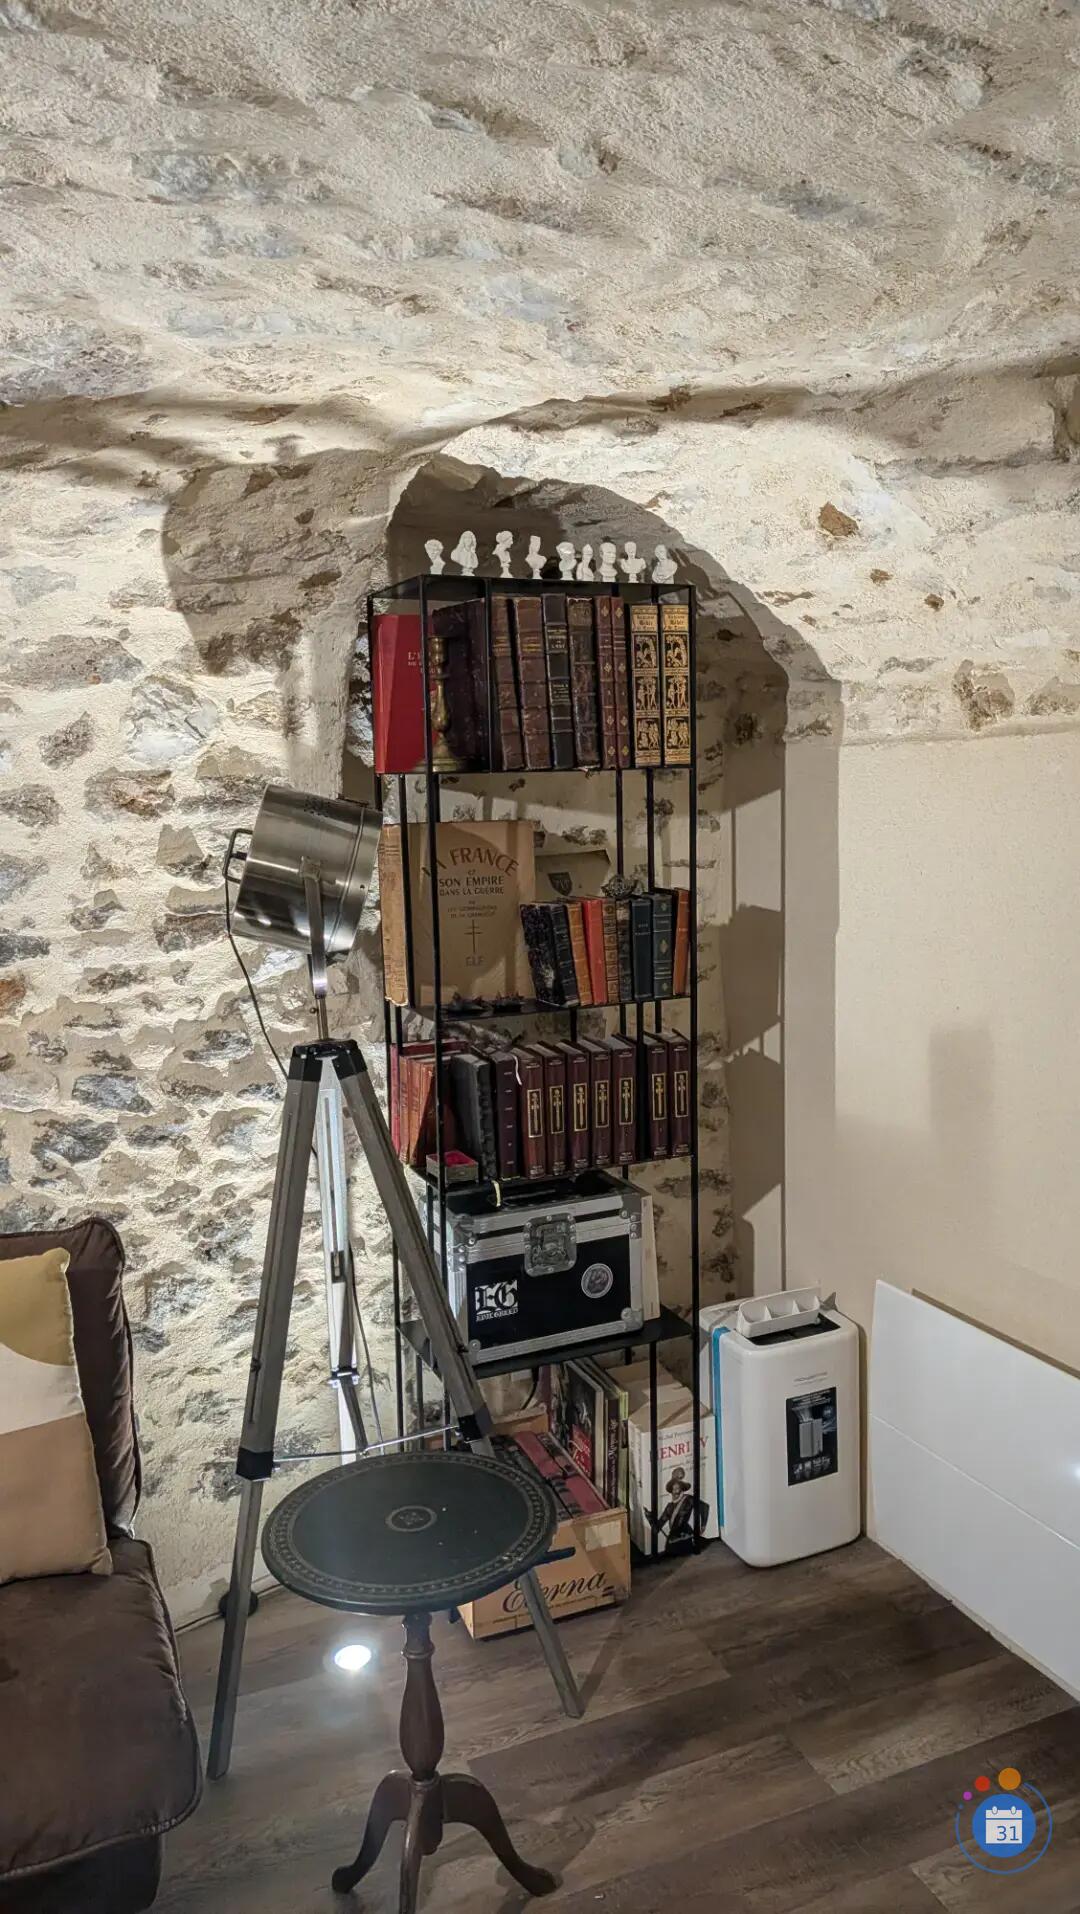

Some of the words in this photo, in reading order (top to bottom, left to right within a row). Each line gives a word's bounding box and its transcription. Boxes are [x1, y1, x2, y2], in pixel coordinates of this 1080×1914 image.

[449, 847, 519, 877] FRANCE
[439, 878, 461, 888] SON
[466, 875, 504, 887] EMPIRE
[439, 889, 460, 897] DANS
[462, 888, 472, 896] LA
[656, 1442, 691, 1460] ENRI
